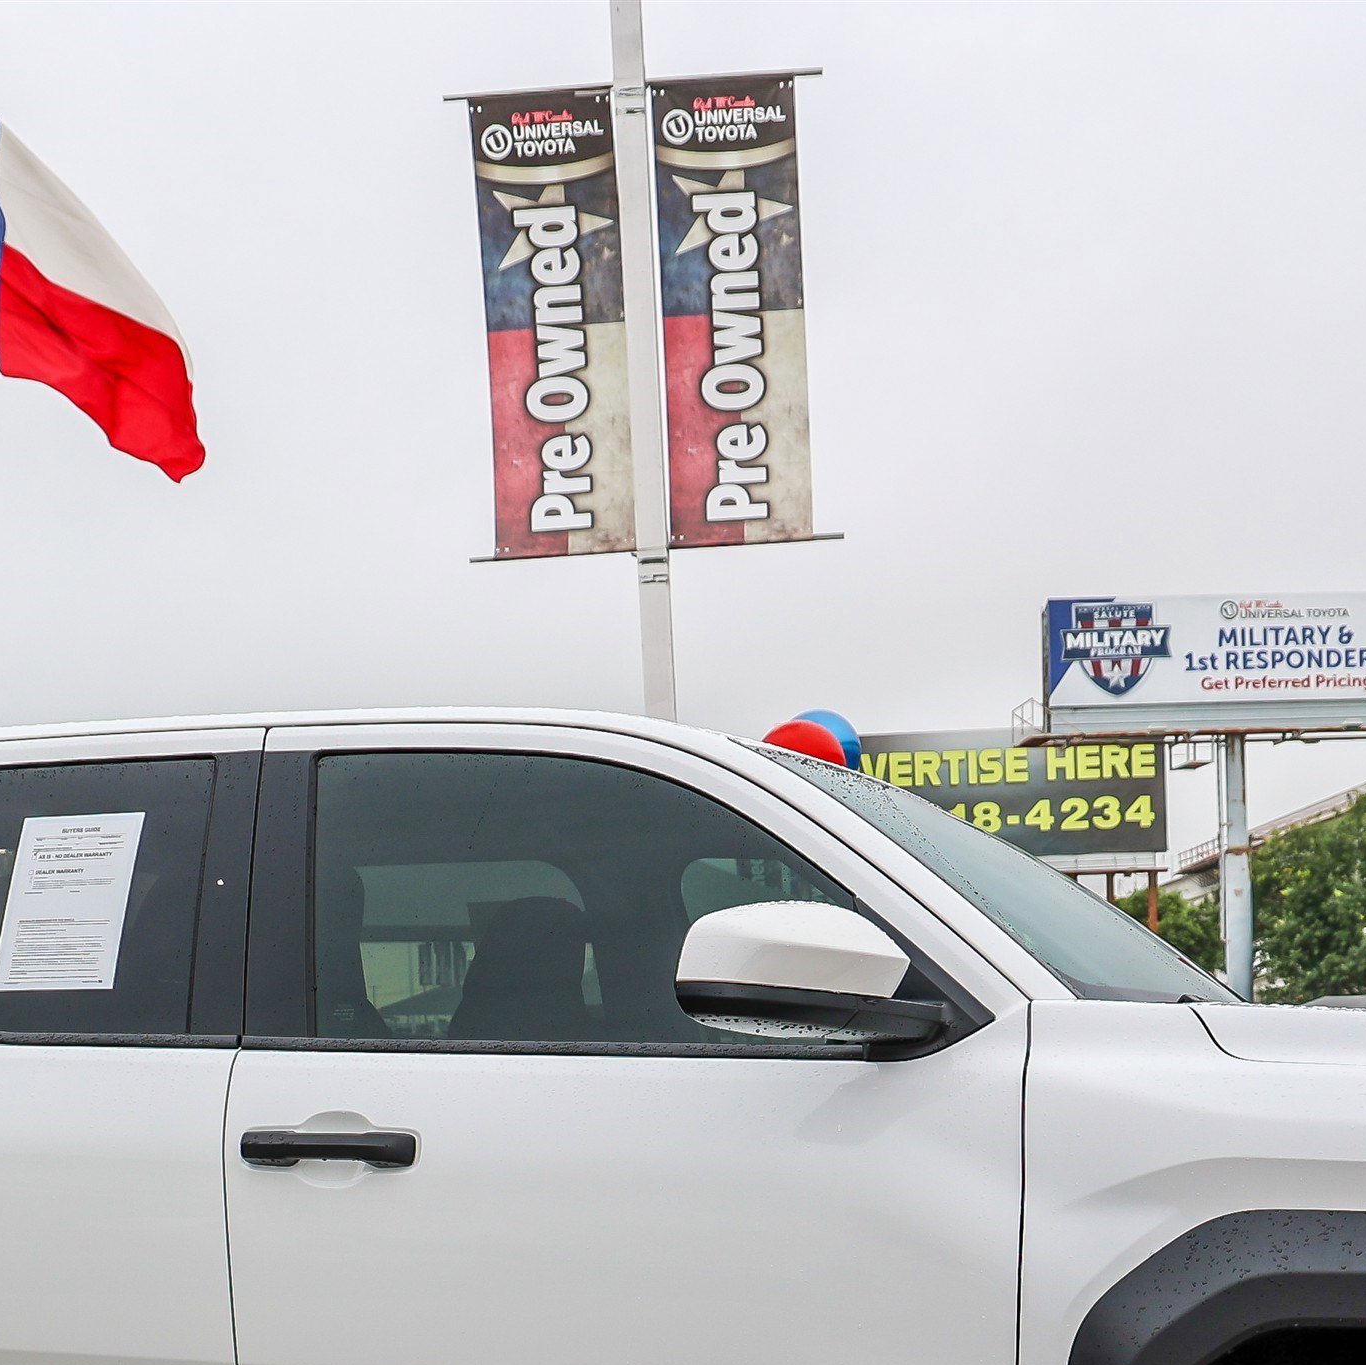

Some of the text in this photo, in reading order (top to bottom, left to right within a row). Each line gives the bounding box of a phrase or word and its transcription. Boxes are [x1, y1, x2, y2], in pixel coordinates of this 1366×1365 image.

[695, 105, 786, 126] UNIVERSAL
[513, 120, 604, 141] UNIVERSAL
[695, 124, 757, 143] TOYOTA
[514, 139, 576, 158] TOYOTA
[692, 190, 770, 523] Pre Owned
[512, 205, 593, 533] Pre Owned
[1093, 610, 1136, 619] SALUTE
[1240, 608, 1350, 619] UNIVERSAL TOYOTA
[1066, 629, 1165, 650] MILITARY
[1218, 624, 1354, 647] MILITARY &
[1184, 652, 1219, 671] 1st
[1201, 677, 1230, 690] Get
[1235, 675, 1311, 690] Preferred
[859, 743, 1156, 787] VERTISE HERE
